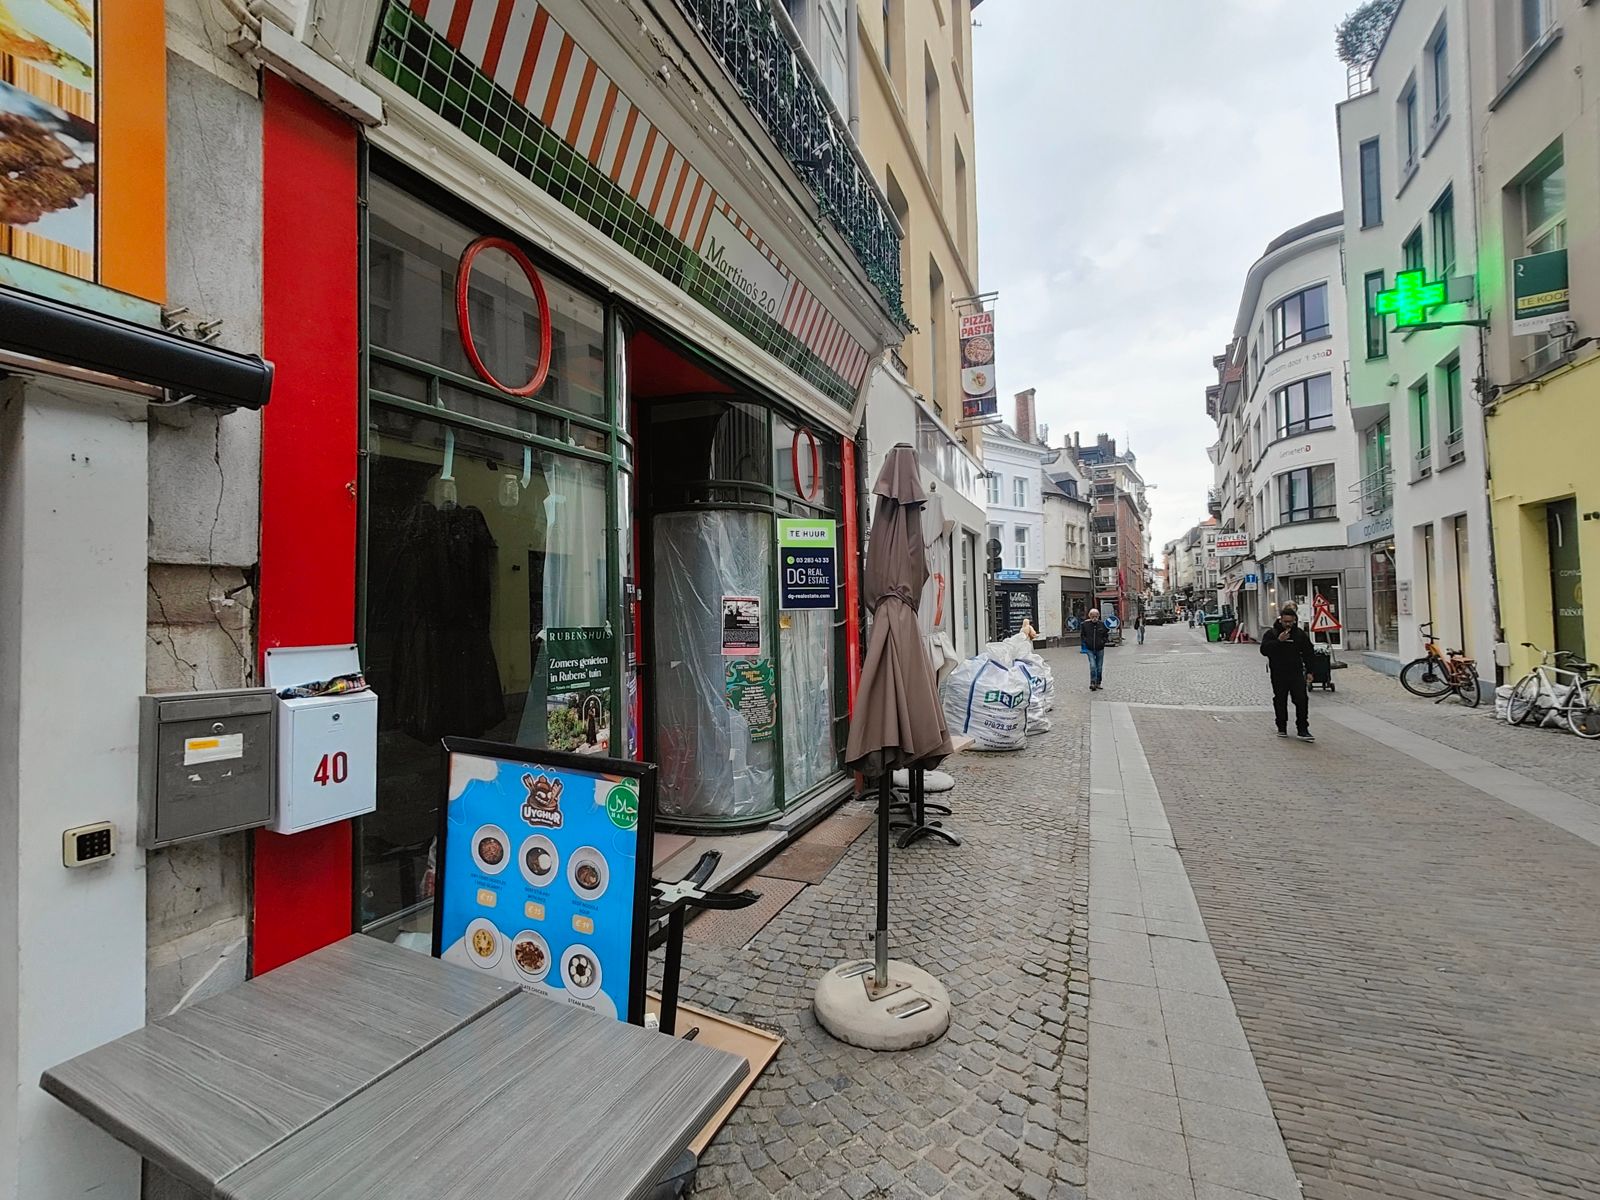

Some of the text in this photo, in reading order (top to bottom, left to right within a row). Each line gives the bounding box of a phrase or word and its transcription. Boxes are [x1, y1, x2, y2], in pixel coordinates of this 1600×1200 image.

[705, 236, 776, 314] Martino's 2.0
[1520, 298, 1534, 306] TE
[963, 314, 992, 326] PIZZA
[962, 324, 994, 338] PASTA
[787, 568, 806, 584] DG
[550, 631, 611, 641] RUBENSHUIS
[550, 656, 608, 669] Zomers genieten
[550, 668, 602, 683] in Rubens' tuin
[314, 751, 348, 786] 40
[524, 806, 560, 824] UYGHUR
[610, 812, 634, 822] HALAL
